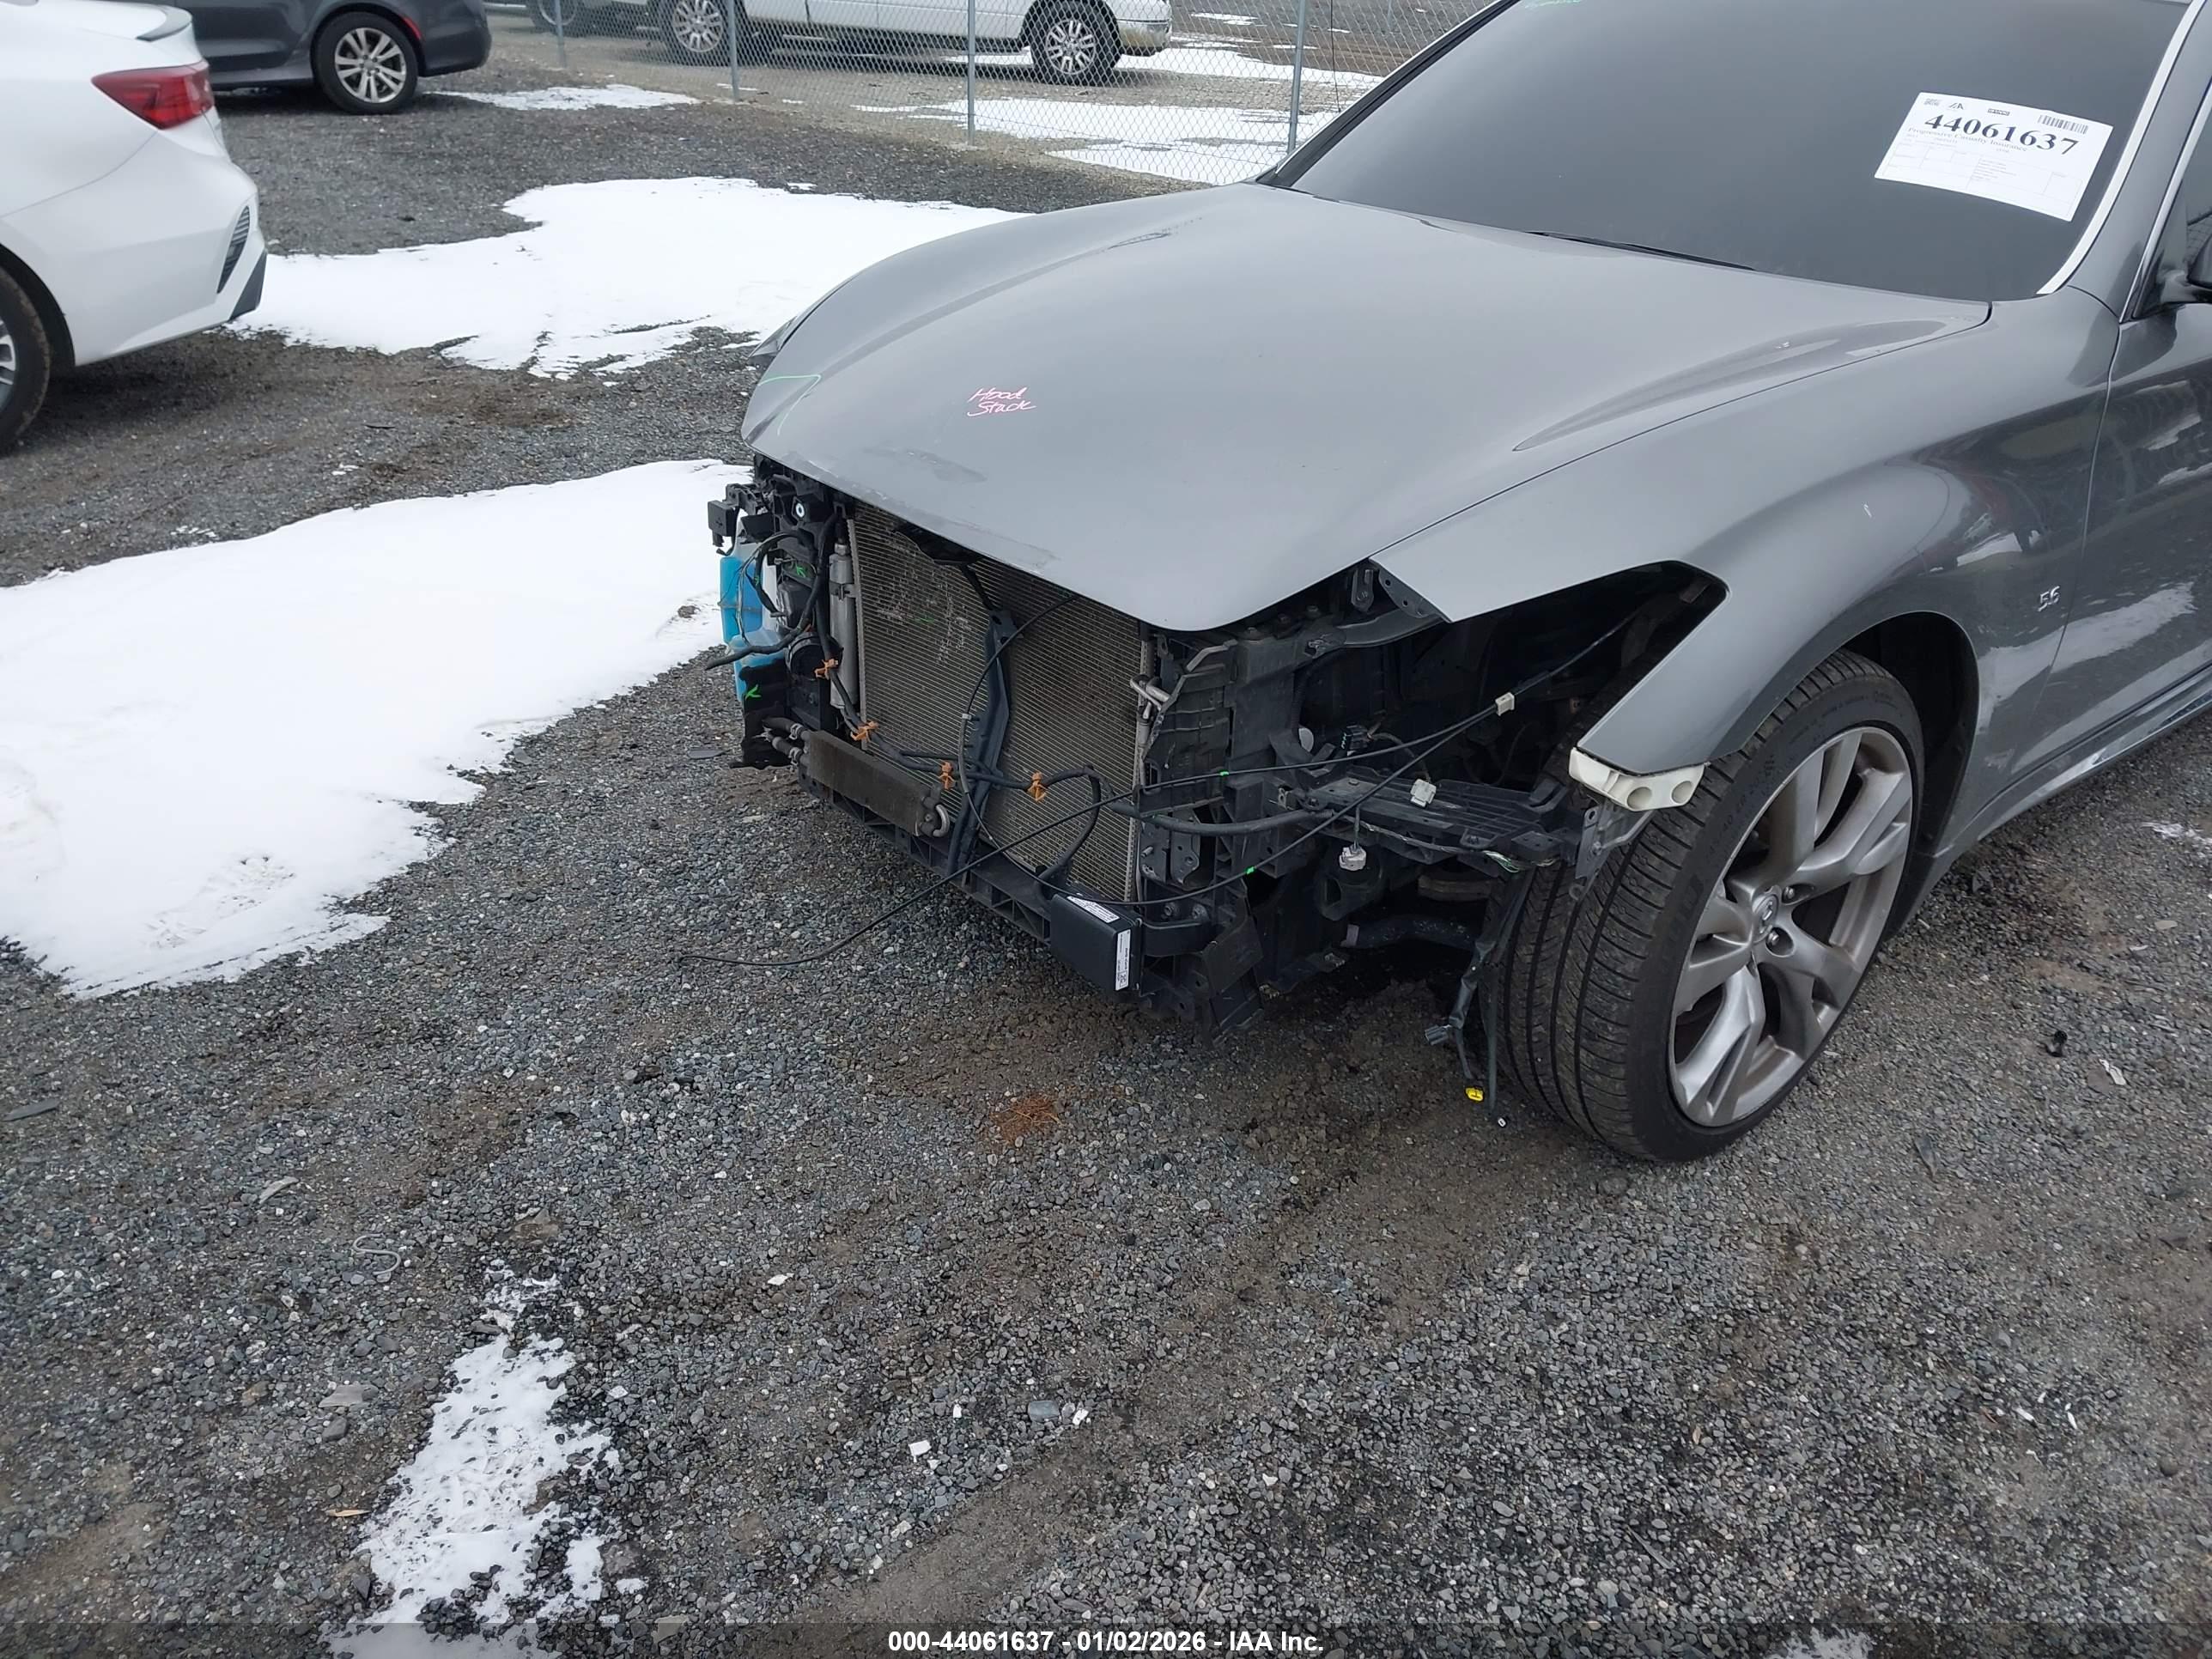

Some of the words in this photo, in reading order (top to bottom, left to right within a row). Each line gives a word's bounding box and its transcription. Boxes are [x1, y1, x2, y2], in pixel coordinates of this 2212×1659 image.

[1924, 114, 2079, 155] 44061637
[1954, 132, 1988, 145] Casualty
[1990, 139, 2028, 152] Insurance
[967, 387, 1028, 403] Hood
